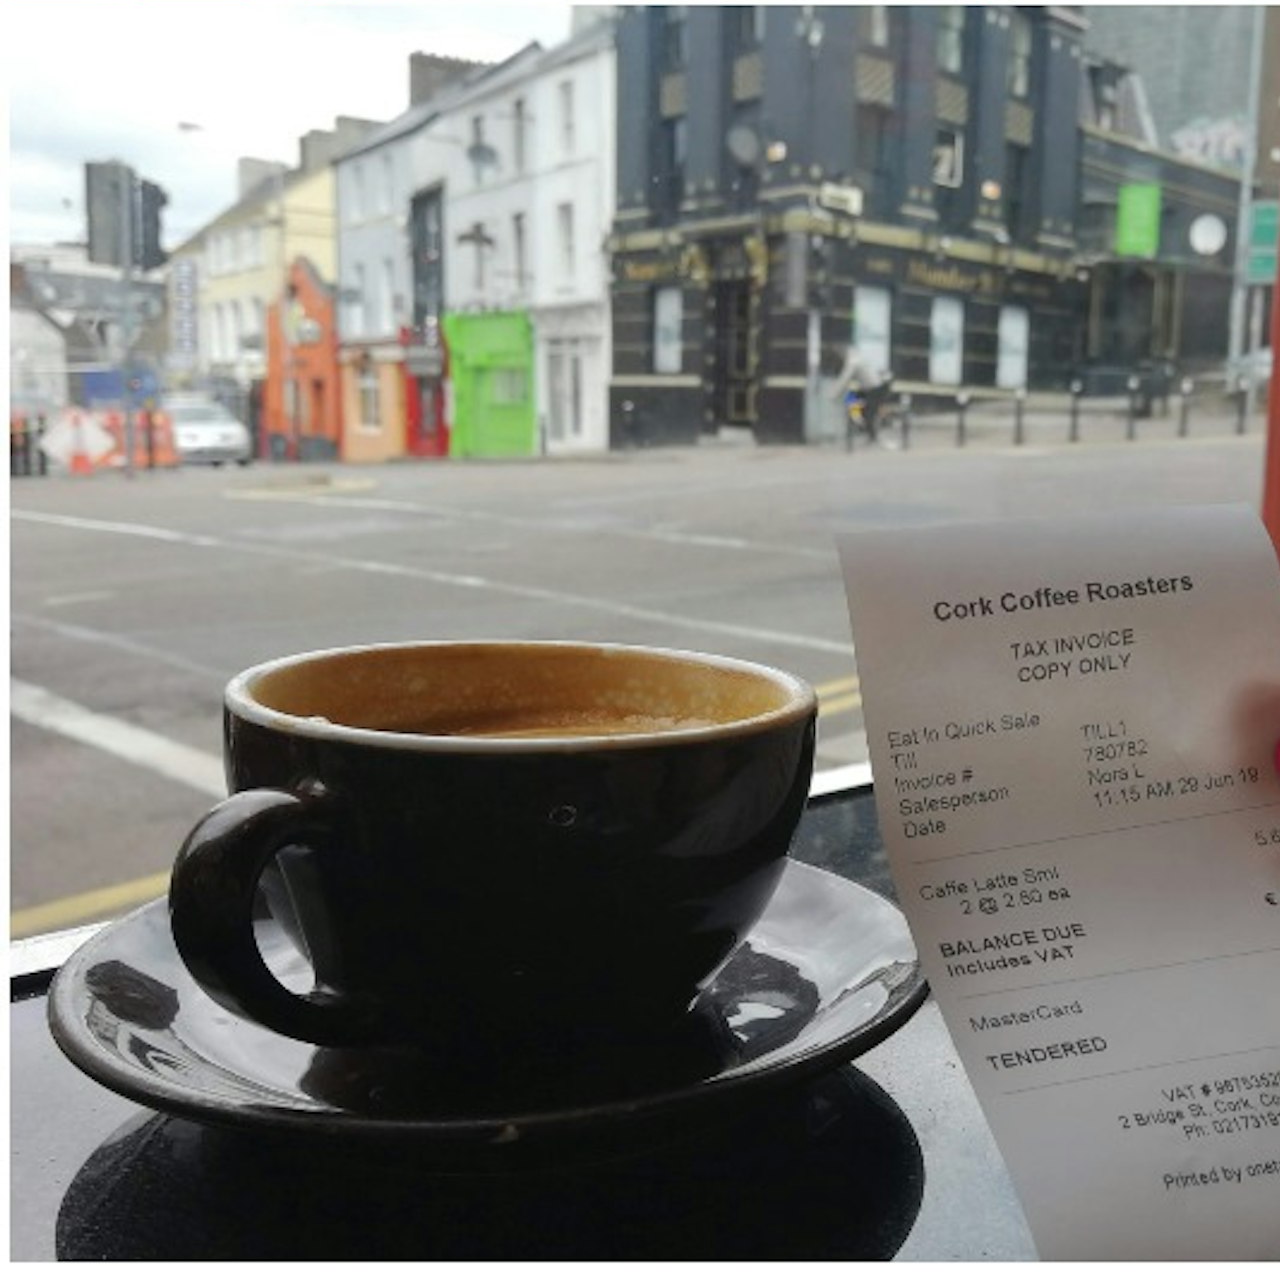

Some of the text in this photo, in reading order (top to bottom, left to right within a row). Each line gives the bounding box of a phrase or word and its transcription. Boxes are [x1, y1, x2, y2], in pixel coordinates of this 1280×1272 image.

[933, 575, 1194, 621] Cork Coffee Roasters
[1010, 628, 1135, 660] TAX INVOICE
[1017, 652, 1132, 682] COPY ONLY
[888, 712, 1041, 749] Eat In Quick Sale
[890, 751, 918, 770] Till
[895, 772, 956, 794] Invoice
[962, 766, 973, 783] #
[900, 786, 1010, 816] Salesperson
[1088, 767, 1129, 786] Nora
[903, 819, 947, 838] Date
[1204, 772, 1234, 790] Jun
[919, 880, 969, 901] Caffe
[974, 872, 1019, 892] Latte
[960, 899, 972, 915] 2
[1048, 887, 1071, 901] ea
[1264, 891, 1278, 906] €
[939, 922, 1087, 959] BALANCE DUE
[946, 945, 1076, 977] Includes VAT
[969, 1000, 1083, 1033] MasterCard
[985, 1036, 1108, 1071] TENDERED
[1161, 1083, 1197, 1103] VAT
[1118, 1115, 1131, 1128] 2
[1133, 1109, 1185, 1126] Bridge
[1163, 1168, 1220, 1190] Printed
[1222, 1167, 1242, 1183] by
